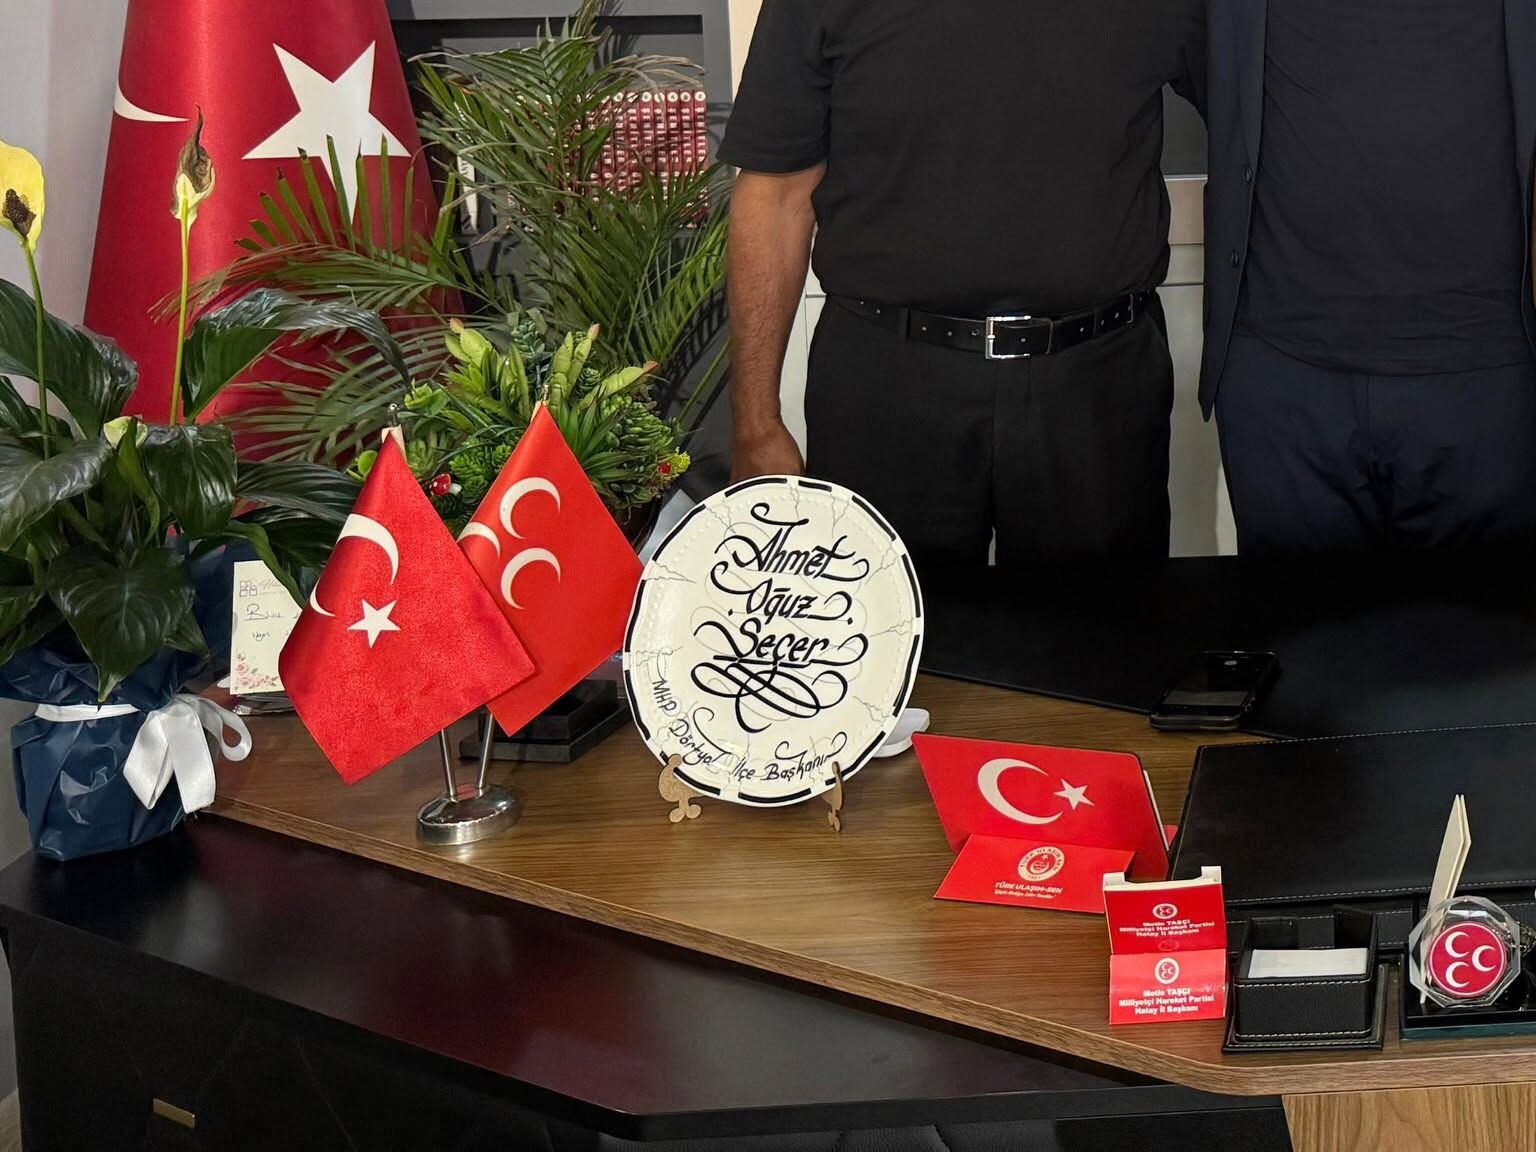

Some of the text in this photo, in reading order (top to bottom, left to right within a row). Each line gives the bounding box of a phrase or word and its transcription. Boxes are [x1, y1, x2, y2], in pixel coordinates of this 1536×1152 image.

[714, 502, 869, 581] Ahmet
[652, 679, 677, 711] MHP
[669, 707, 733, 766] Dörtyol
[995, 881, 1015, 889] TÜRK
[1143, 988, 1191, 997] Metin TAŞÇI
[1119, 994, 1214, 1007] Milliyetçi Hareket Partisi
[1135, 1006, 1158, 1015] Hatay
[1167, 1004, 1198, 1013] Başkanı
